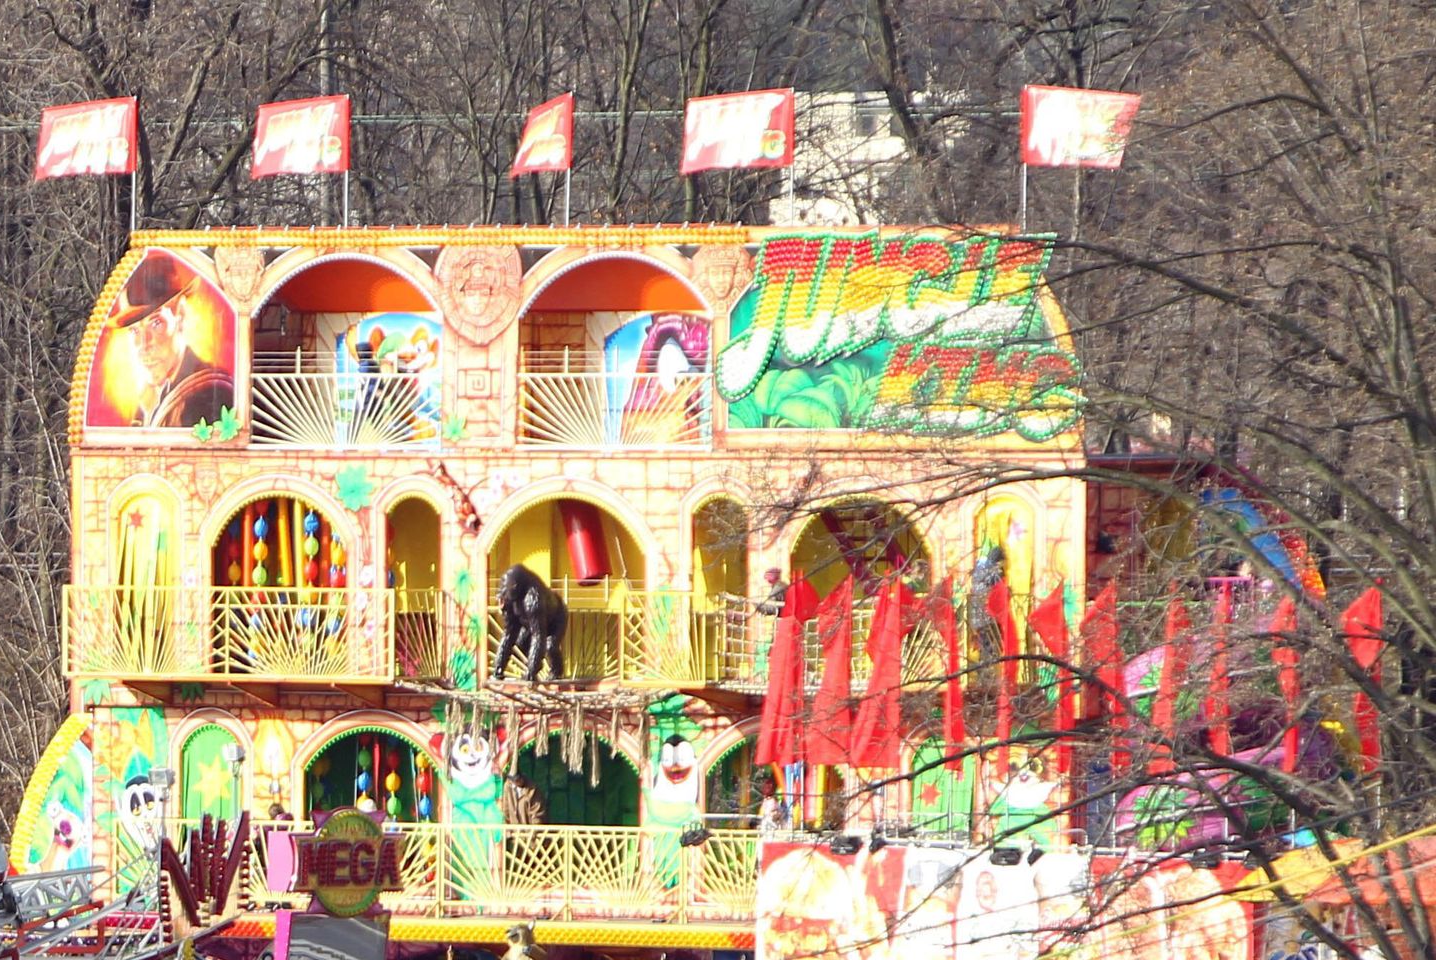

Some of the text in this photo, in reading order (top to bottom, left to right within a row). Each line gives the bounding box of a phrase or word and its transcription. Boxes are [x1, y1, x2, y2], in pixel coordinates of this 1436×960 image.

[717, 231, 1057, 401] JUNGLE
[869, 340, 1087, 443] KING
[299, 839, 401, 887] MEGA
